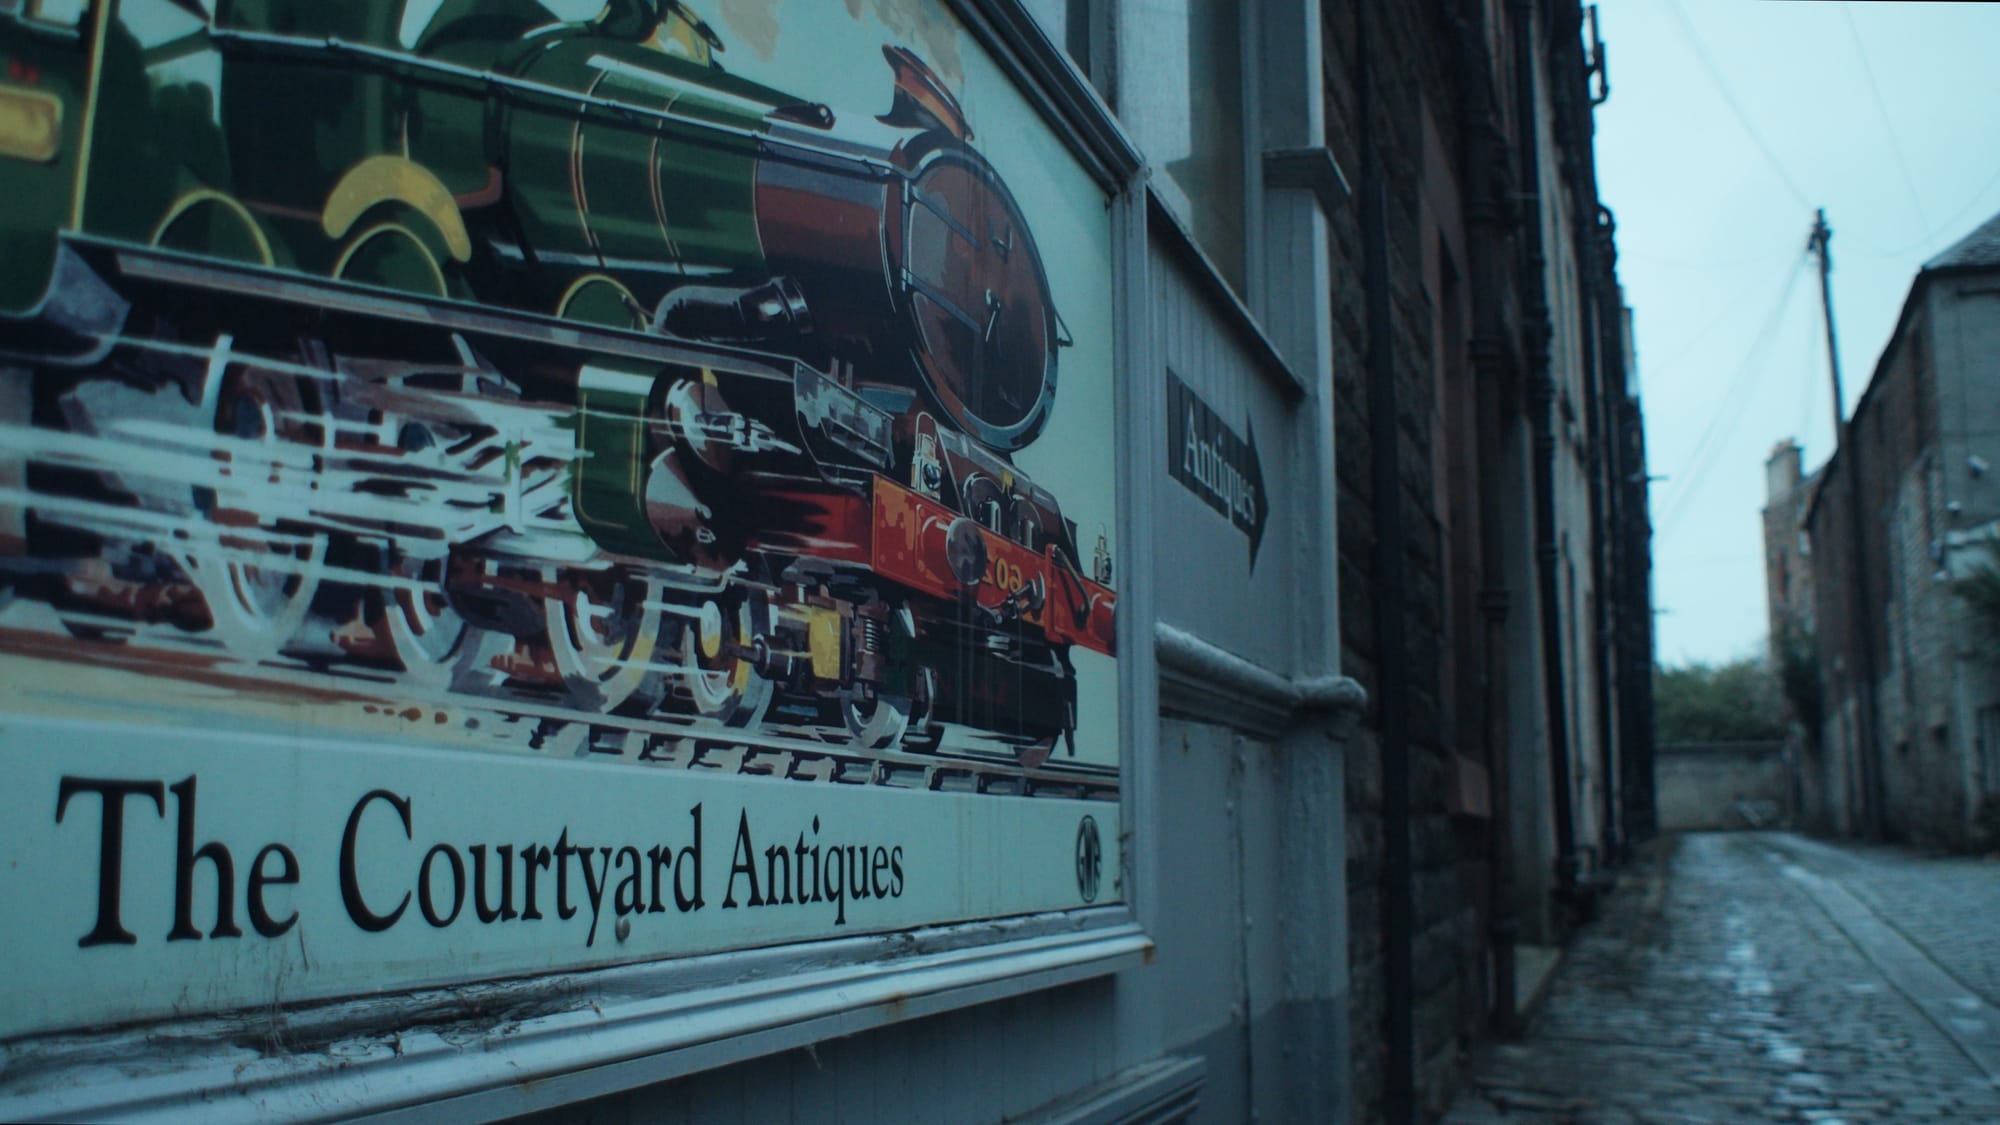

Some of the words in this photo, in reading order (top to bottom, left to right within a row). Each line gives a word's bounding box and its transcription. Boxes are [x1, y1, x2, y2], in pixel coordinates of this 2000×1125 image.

[1184, 401, 1256, 525] Antiques
[55, 774, 300, 949] The
[338, 789, 706, 947] Courtyard
[721, 807, 904, 926] Antiques
